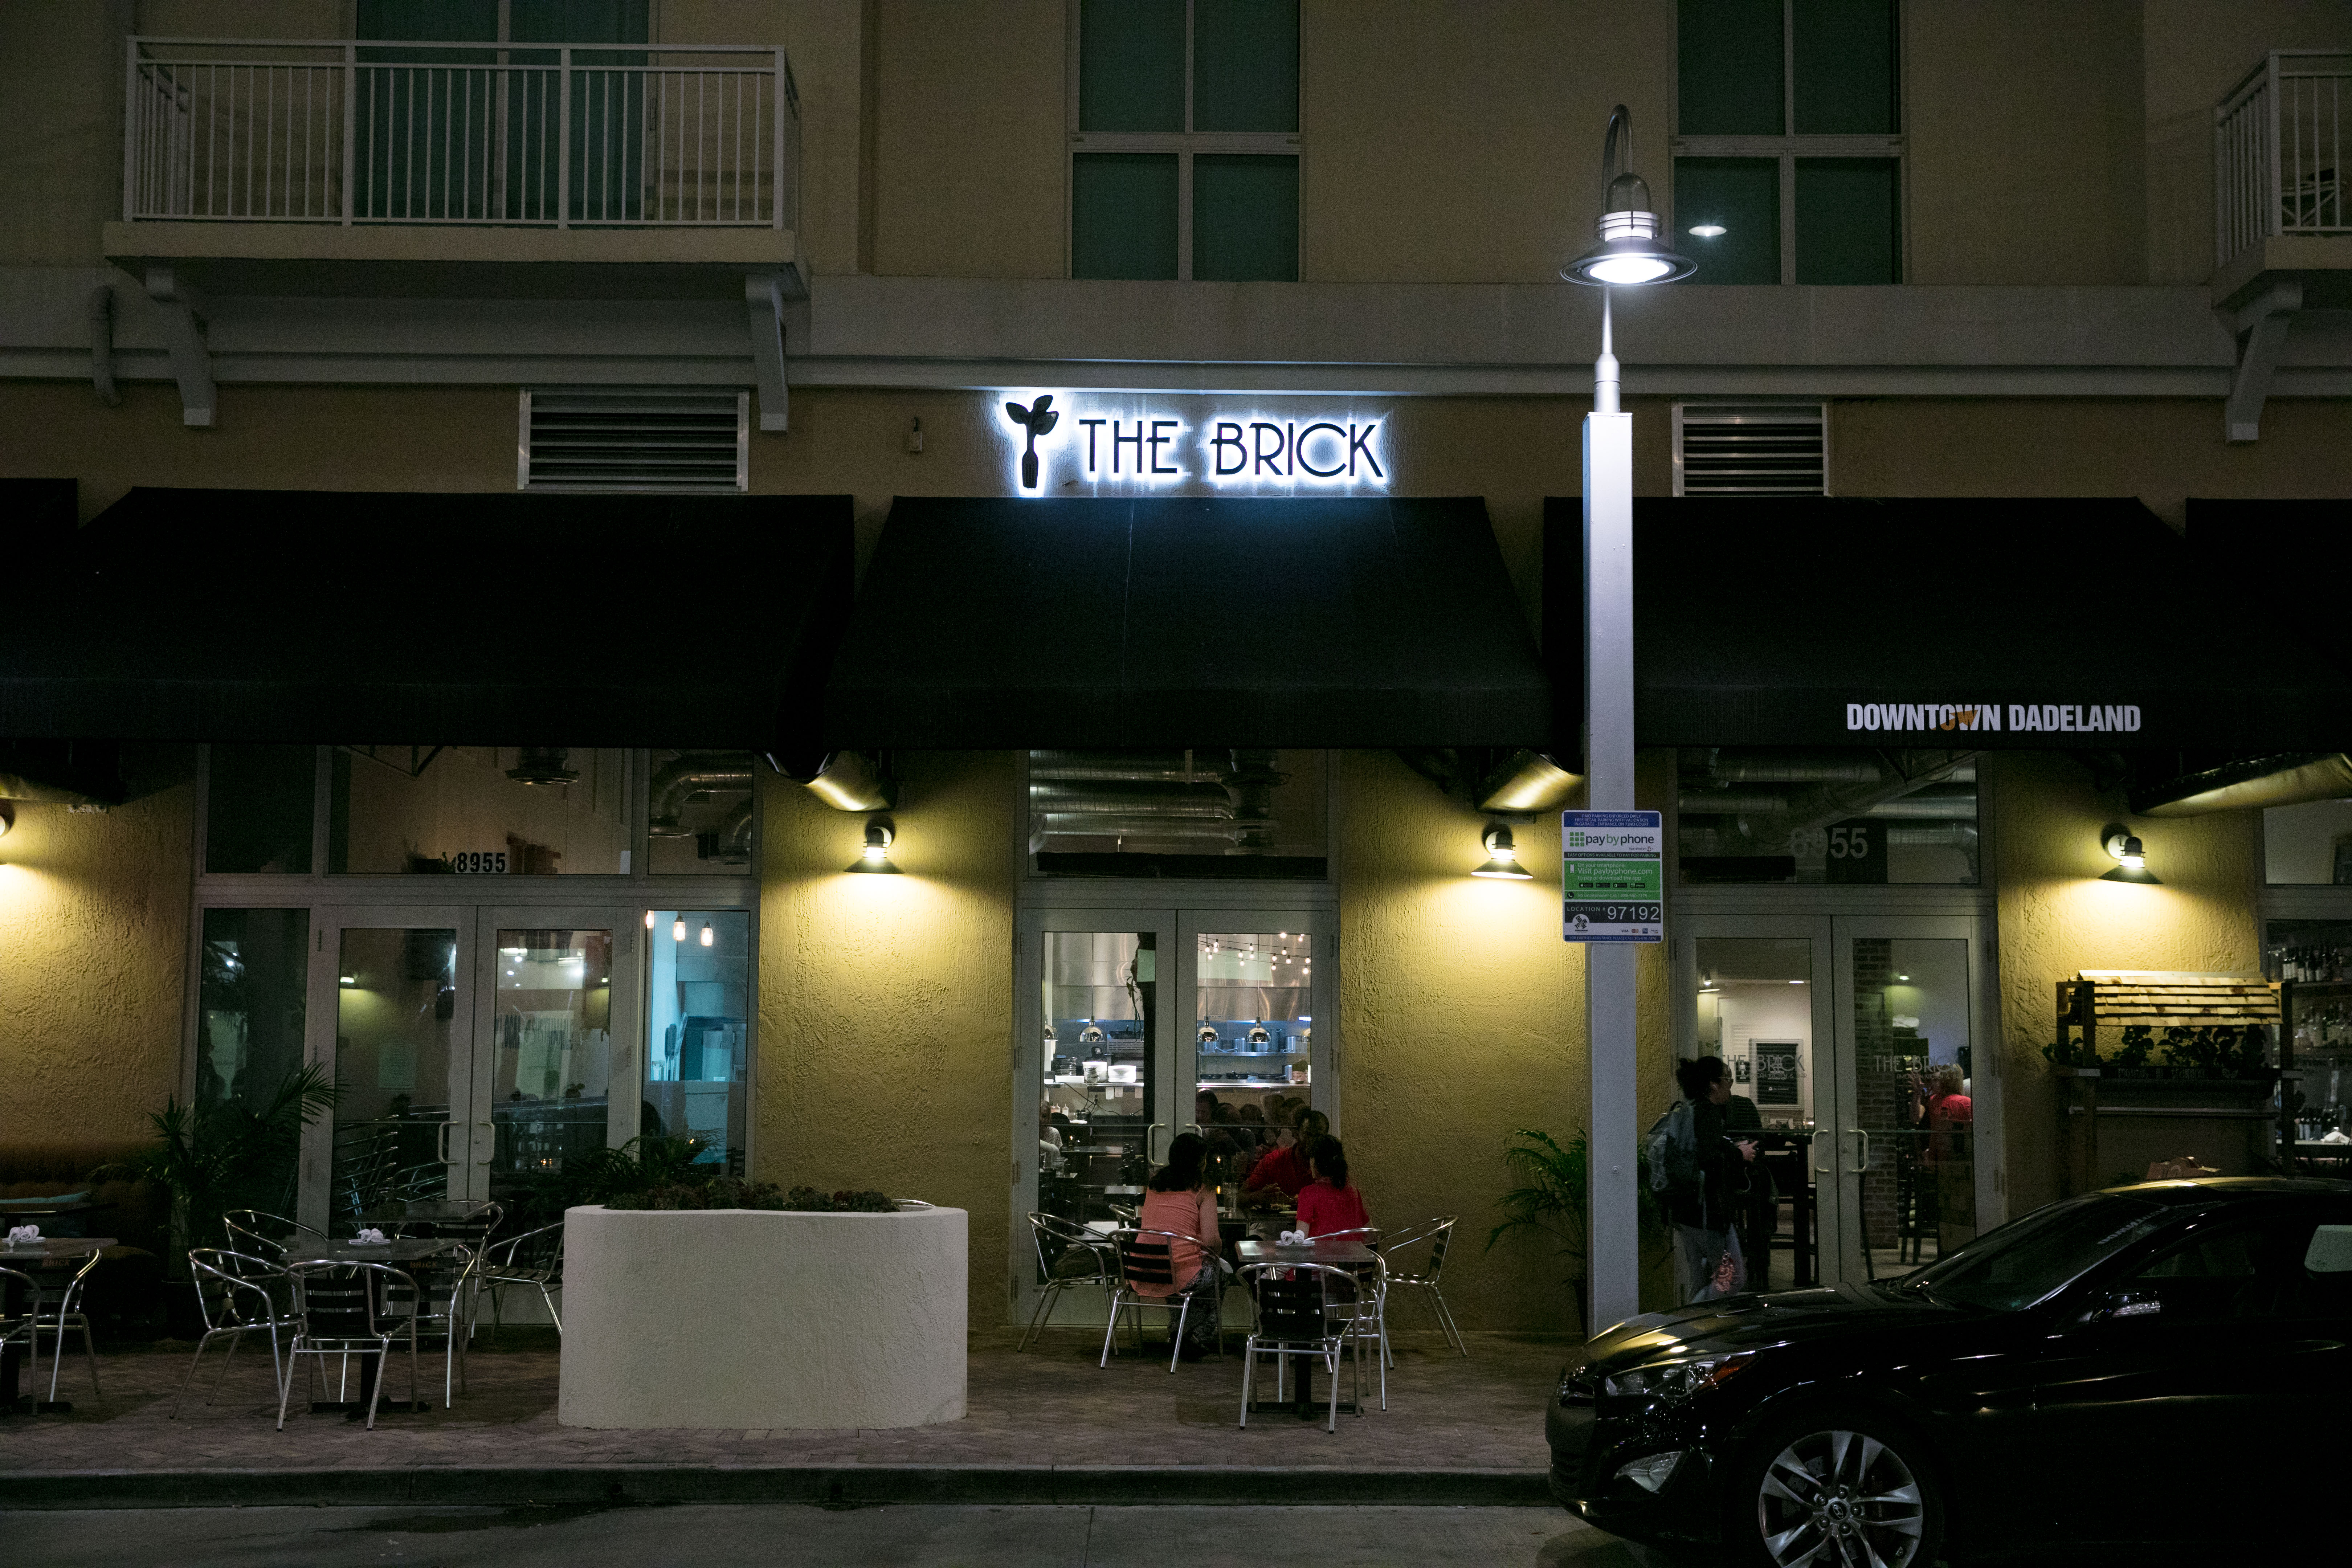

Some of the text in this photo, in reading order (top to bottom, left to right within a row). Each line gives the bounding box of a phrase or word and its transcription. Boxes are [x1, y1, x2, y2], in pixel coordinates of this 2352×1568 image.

[1079, 419, 1384, 478] THE BRICK
[1847, 703, 2141, 732] DOWNTOWN DADELAND
[457, 852, 506, 873] 8955
[1607, 906, 1659, 920] 97192
[1873, 1055, 1902, 1072] THE
